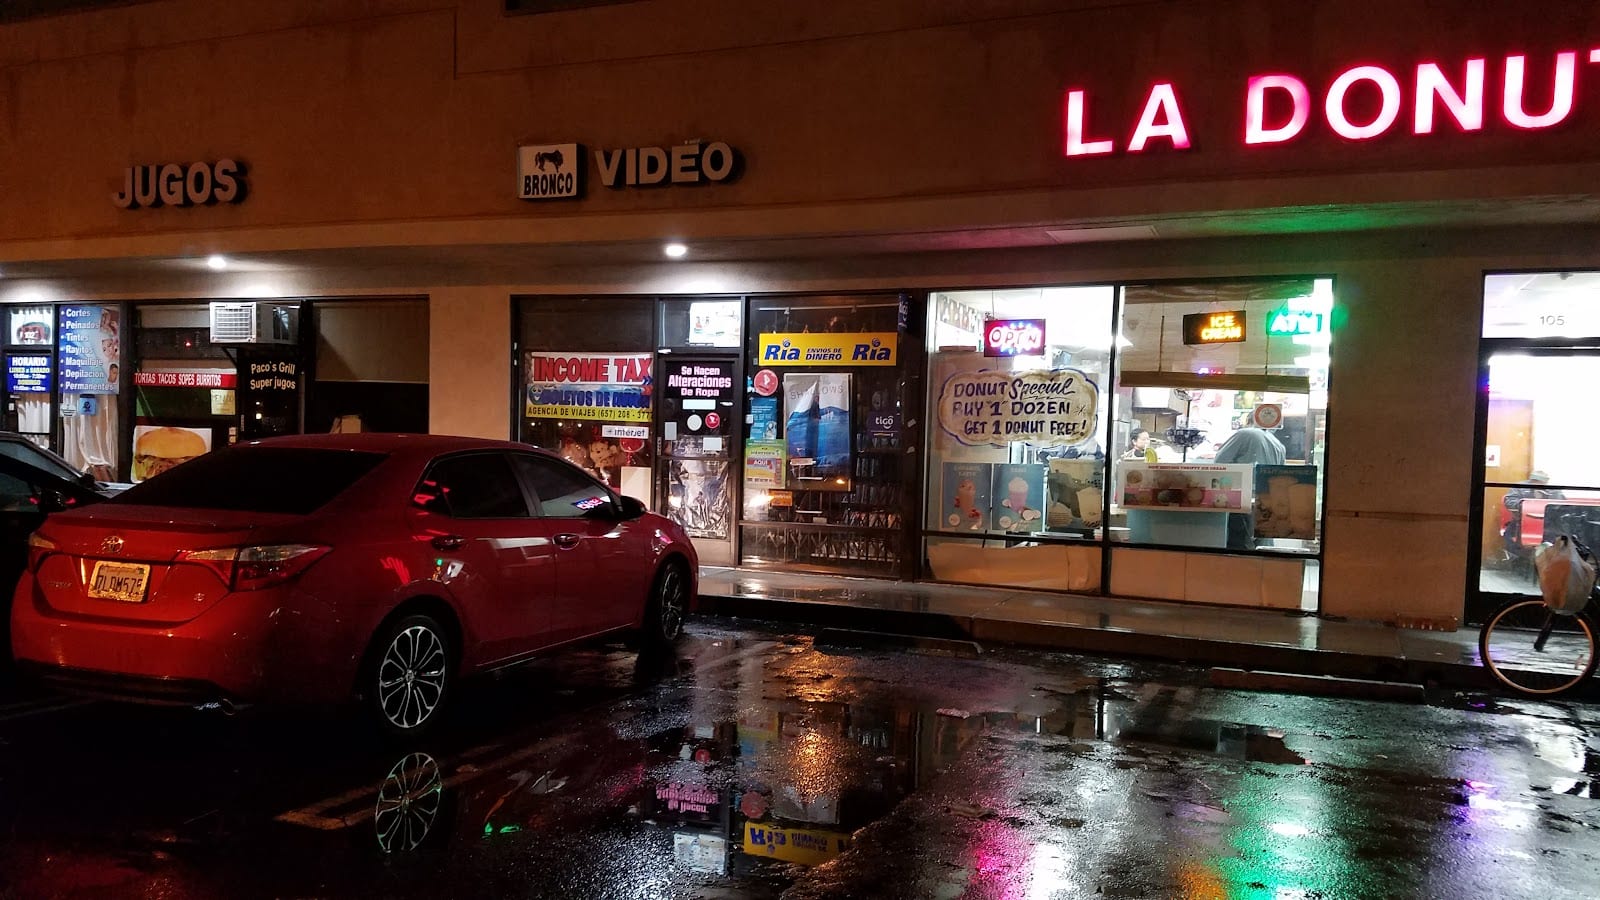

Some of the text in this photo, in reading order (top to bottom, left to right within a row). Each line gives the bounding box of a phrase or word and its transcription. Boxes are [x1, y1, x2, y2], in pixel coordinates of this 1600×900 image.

[1065, 49, 1600, 157] LA DONU
[594, 141, 733, 187] VIDEO
[112, 159, 238, 208] JUGOS
[523, 172, 573, 196] BRONCO
[66, 308, 91, 318] Cortes
[65, 320, 99, 330] Peinados
[1210, 315, 1235, 328] ICE
[1540, 315, 1565, 326] 105
[66, 332, 89, 342] Tintes
[1201, 327, 1242, 340] CREAM
[764, 338, 801, 361] Ria
[851, 338, 891, 361] Ria
[12, 356, 48, 367] HORARIO
[805, 353, 842, 361] DINERO
[251, 361, 296, 375] Paco's Grill
[533, 357, 652, 383] INCOME TAX
[681, 366, 720, 376] Se Hacen
[65, 380, 115, 391] Permanentes
[135, 373, 221, 386] TORTAS TACOS SOPES BURRITOS
[250, 376, 296, 390] Super jugos
[668, 375, 731, 388] Alteraciones
[681, 388, 720, 397] De Ropa
[790, 384, 844, 400] SHOWS
[954, 378, 1075, 399] DONUT Special
[528, 407, 558, 415] AGENCIA
[560, 407, 568, 416] DE
[571, 408, 596, 417] VIAJES
[597, 410, 616, 419] (657)
[952, 401, 984, 417] BUY
[1011, 401, 1070, 416] DOZEN
[964, 419, 1087, 436] GET 1 DONUT FREE!
